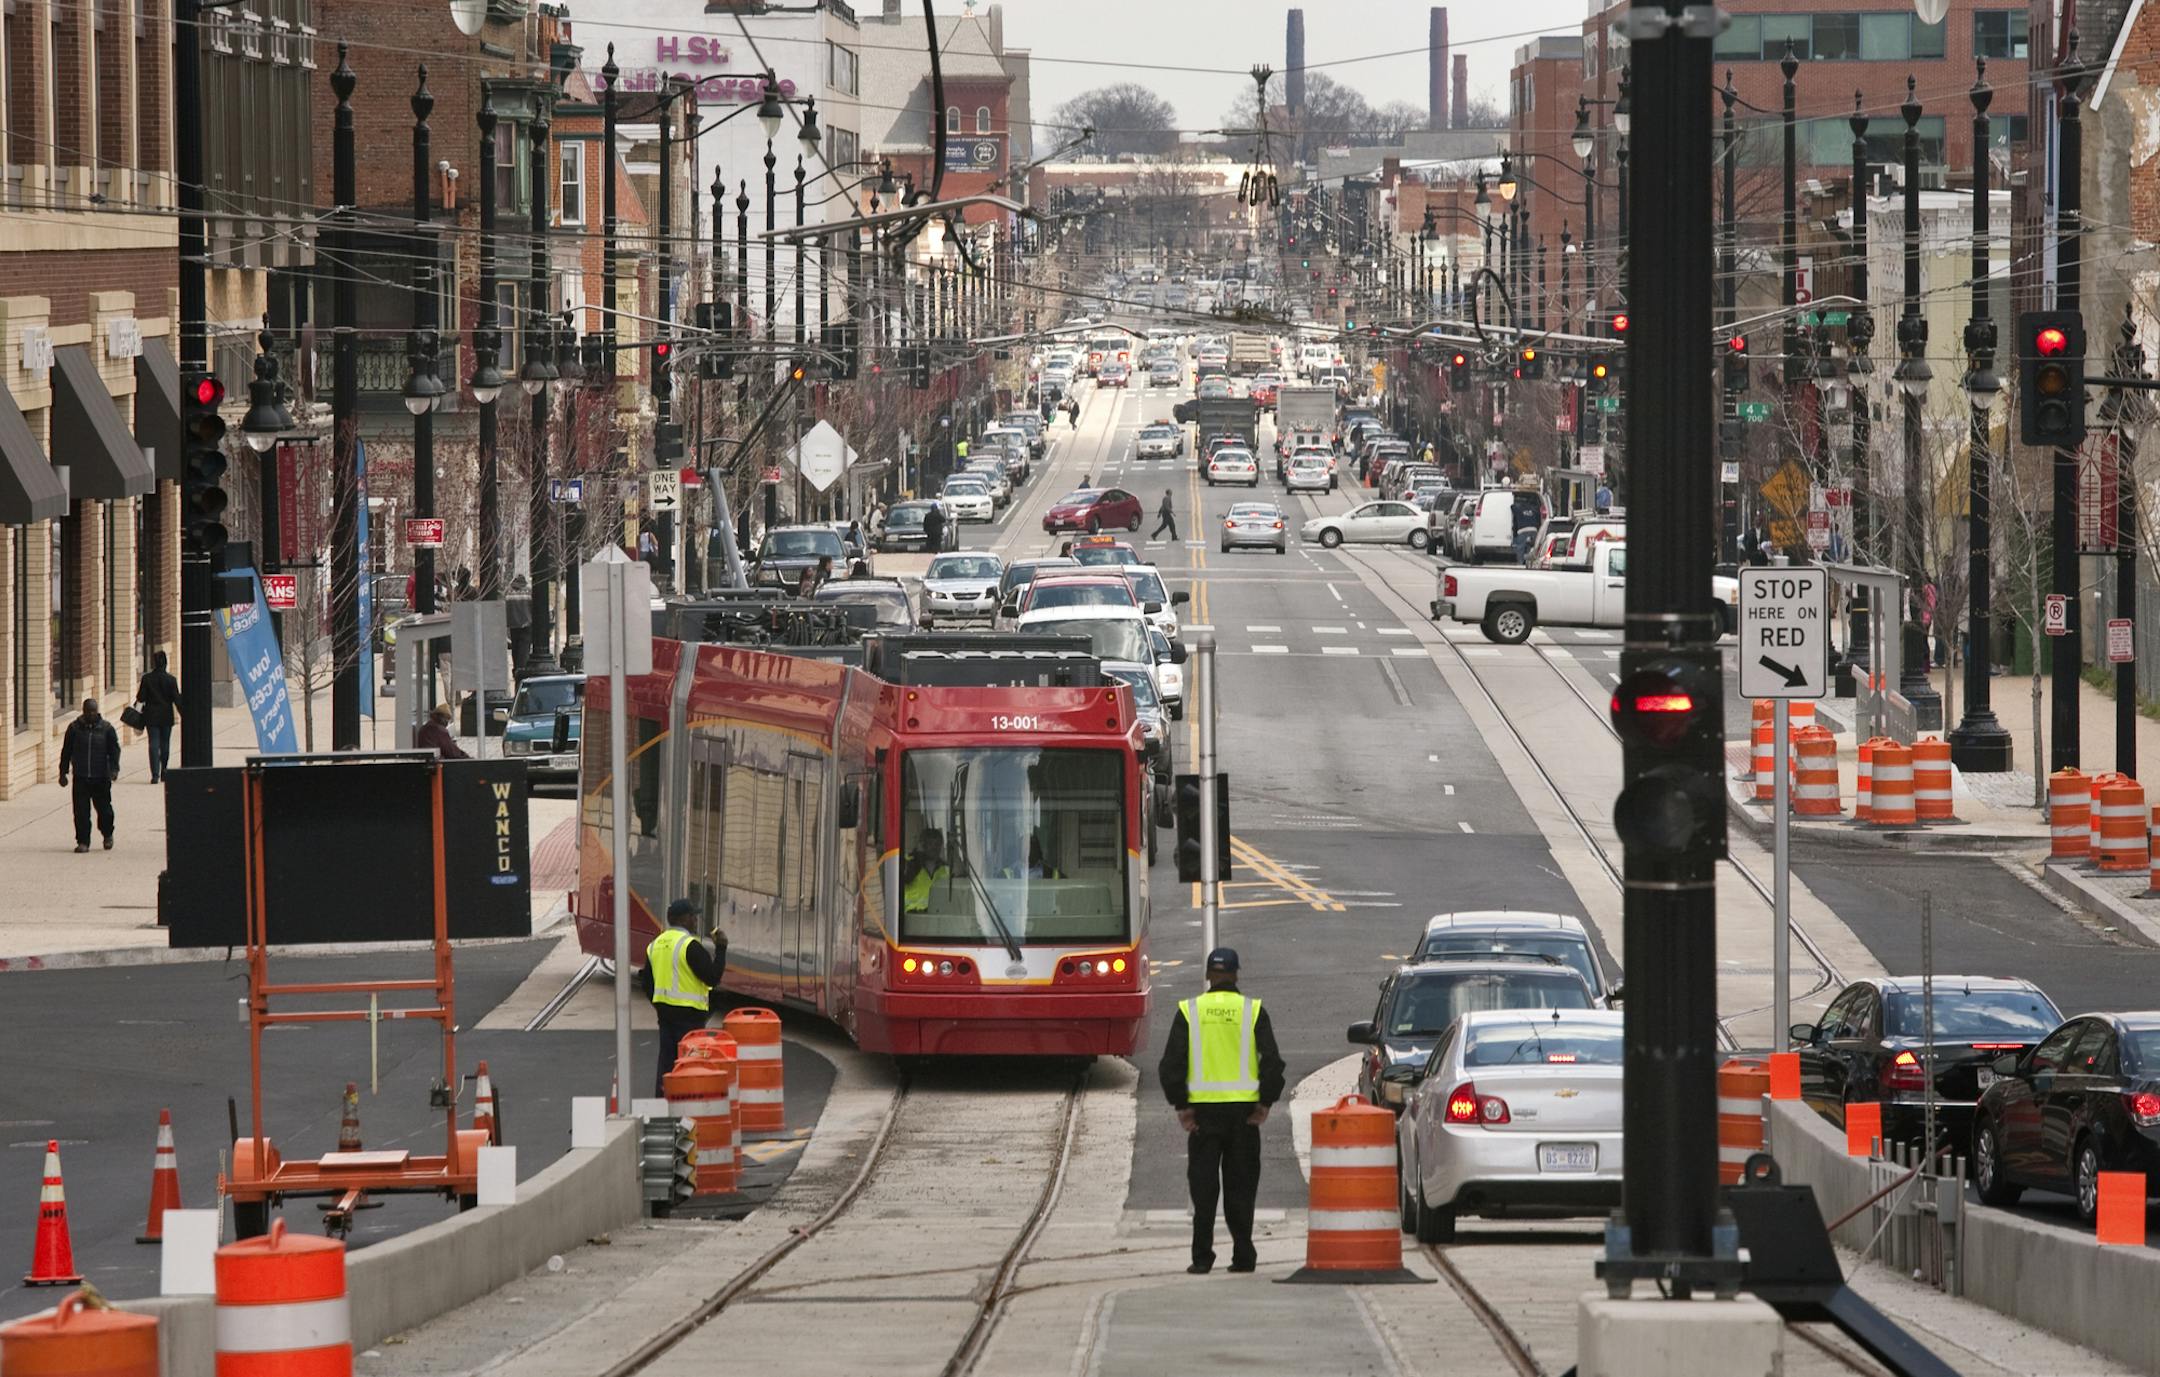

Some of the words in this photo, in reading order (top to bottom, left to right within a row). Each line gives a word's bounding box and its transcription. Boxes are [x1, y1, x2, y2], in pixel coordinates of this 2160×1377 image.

[657, 36, 679, 63] H
[672, 72, 796, 101] torage
[654, 473, 676, 483] ONE
[654, 484, 676, 494] WAY
[1754, 580, 1813, 599] STOP
[1748, 607, 1785, 620] HERE
[1797, 607, 1818, 620] ON
[1761, 627, 1805, 647] RED
[991, 715, 1039, 730] 13-001
[491, 782, 512, 873] WANCO
